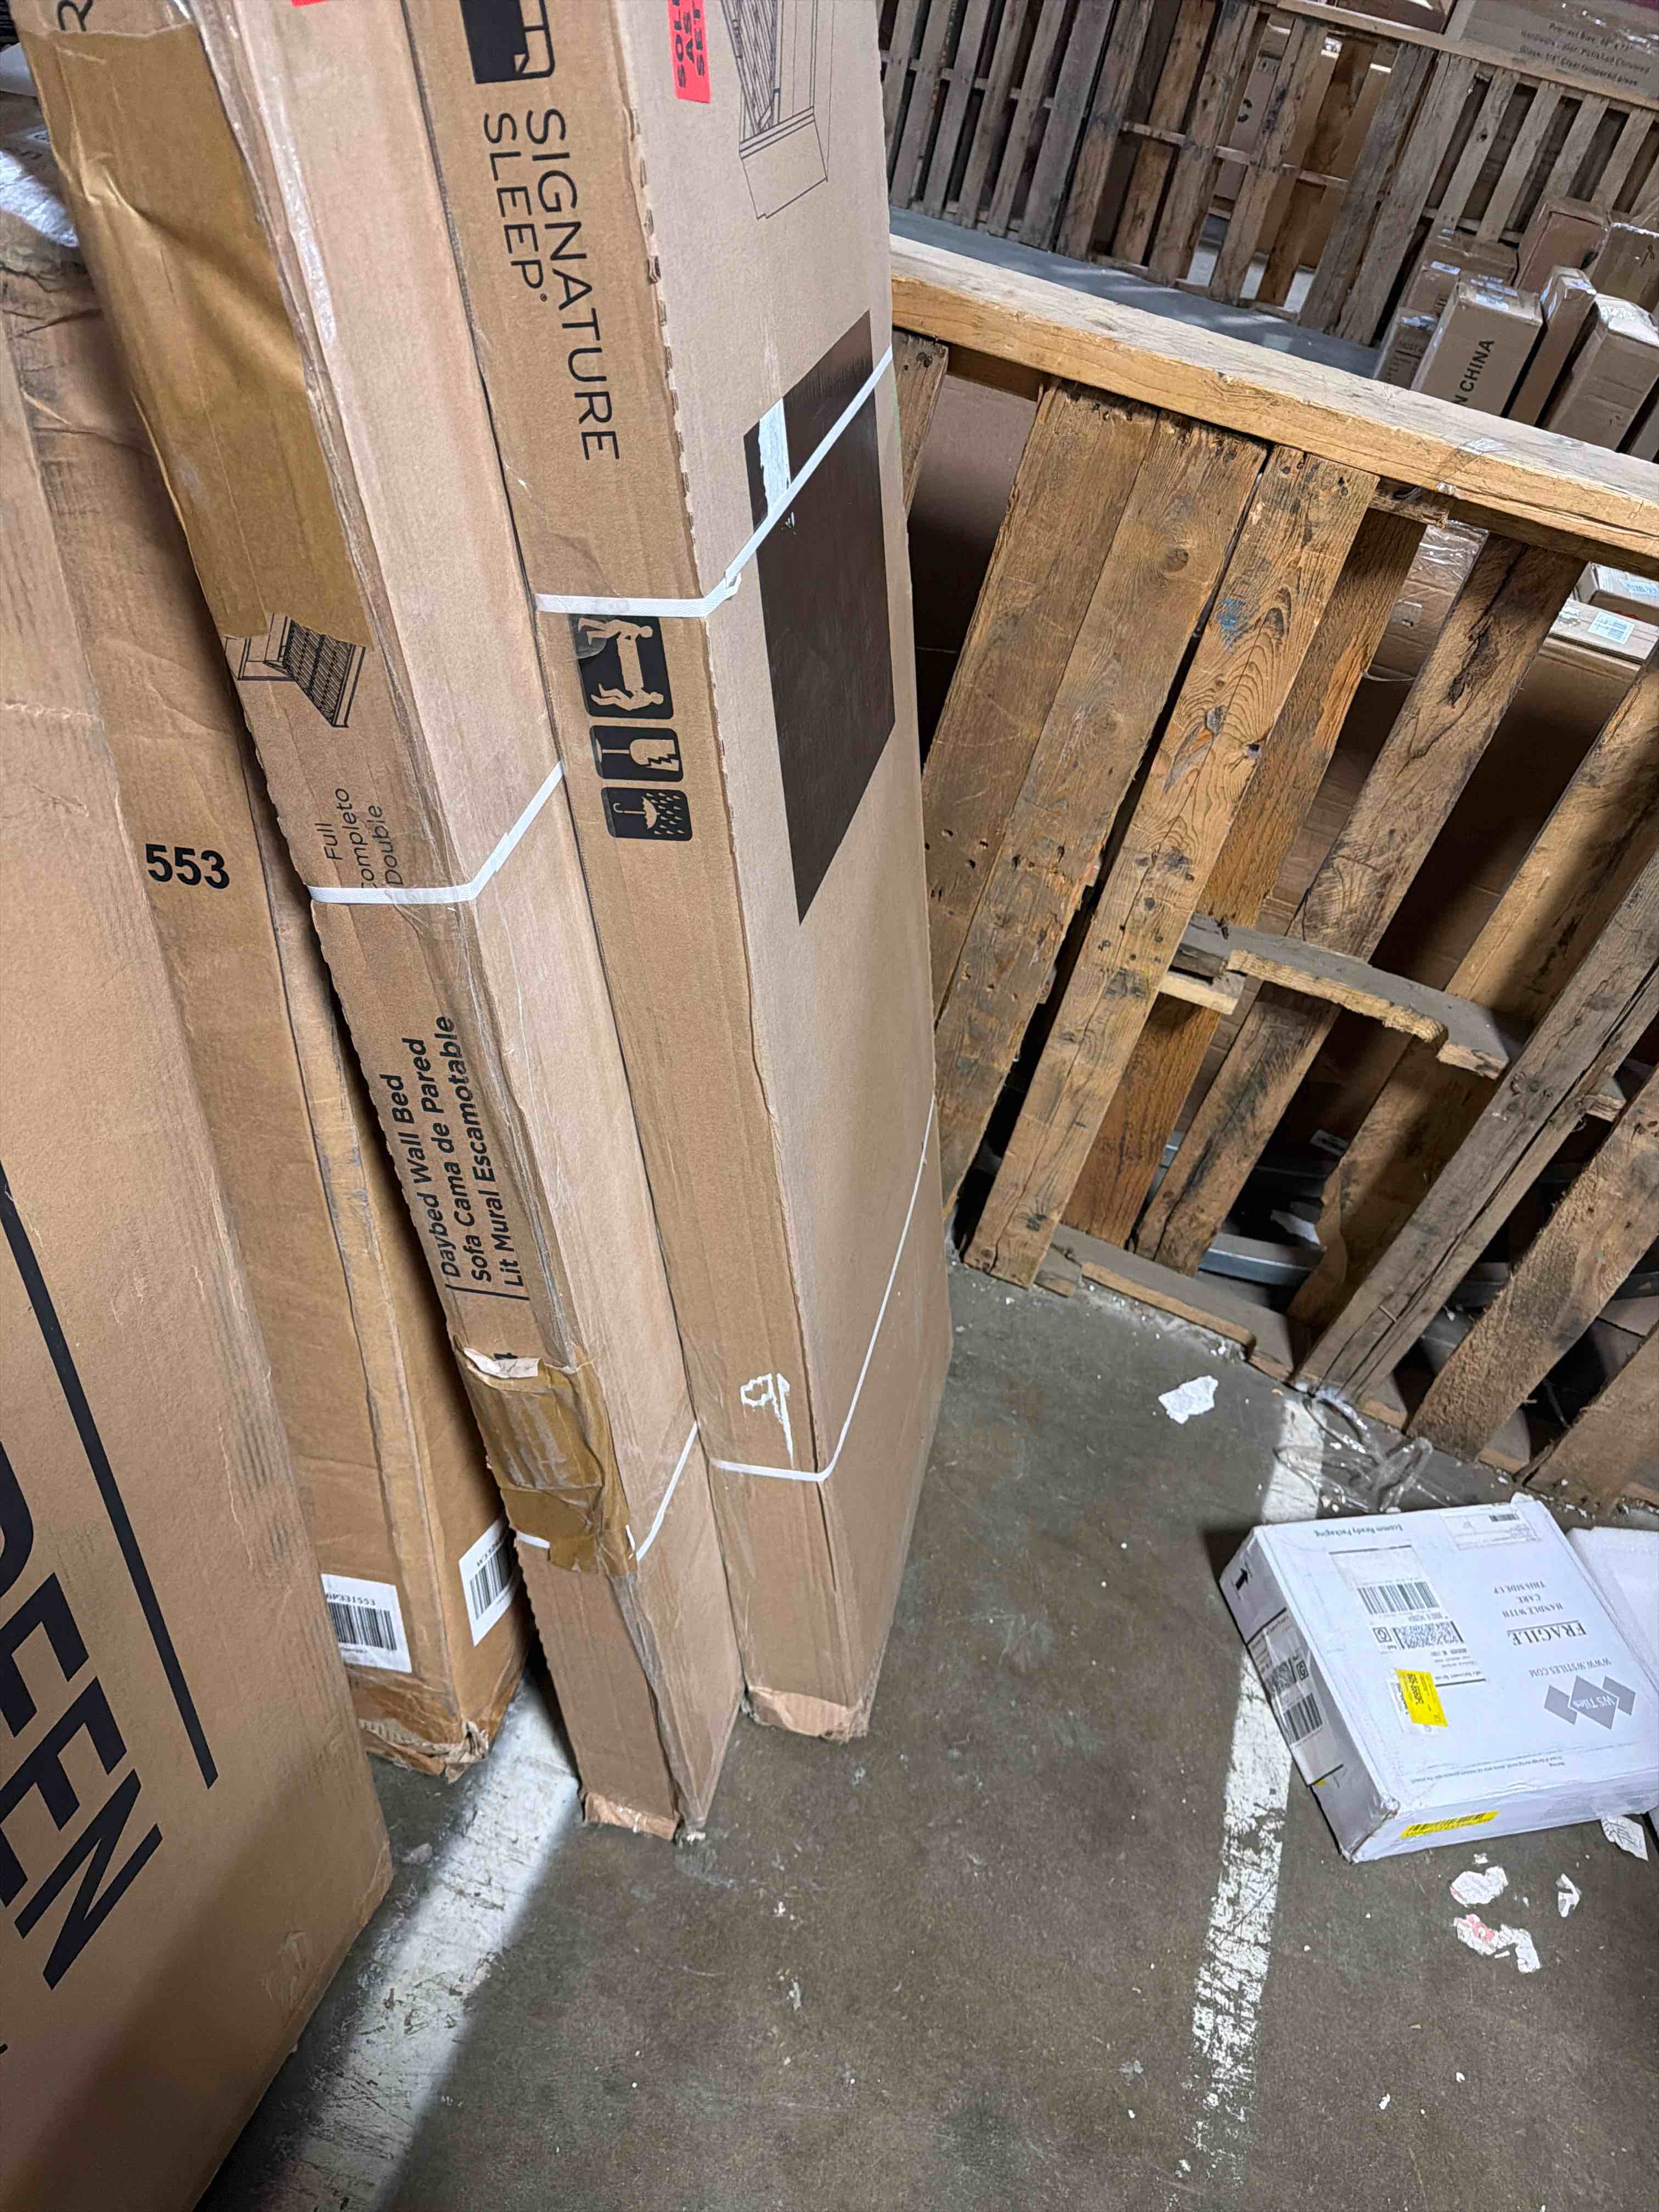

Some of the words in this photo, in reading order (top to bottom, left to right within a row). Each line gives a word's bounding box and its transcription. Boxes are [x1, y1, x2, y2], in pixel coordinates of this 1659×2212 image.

[527, 109, 620, 461] SIGNATURE
[1459, 339, 1495, 393] CHINA
[145, 843, 230, 889] 553
[314, 823, 343, 860] Full
[366, 805, 404, 885] Double
[379, 1074, 415, 1124] Bed
[402, 1037, 444, 1114] Pared
[434, 1017, 496, 1182] Escamotable
[398, 1132, 433, 1184] Wall
[430, 1122, 455, 1154] de
[444, 1161, 475, 1227] Cama
[416, 1192, 462, 1278] Daybed
[477, 1189, 515, 1252] Mural
[462, 1234, 492, 1283] Sofa
[500, 1258, 524, 1287] Lit
[1502, 1609, 1527, 1619] WITH
[1516, 1594, 1542, 1604] CARE
[1528, 1602, 1564, 1616] HANDLE
[1507, 1622, 1587, 1646] FRAGILE
[1595, 1694, 1616, 1707] WS
